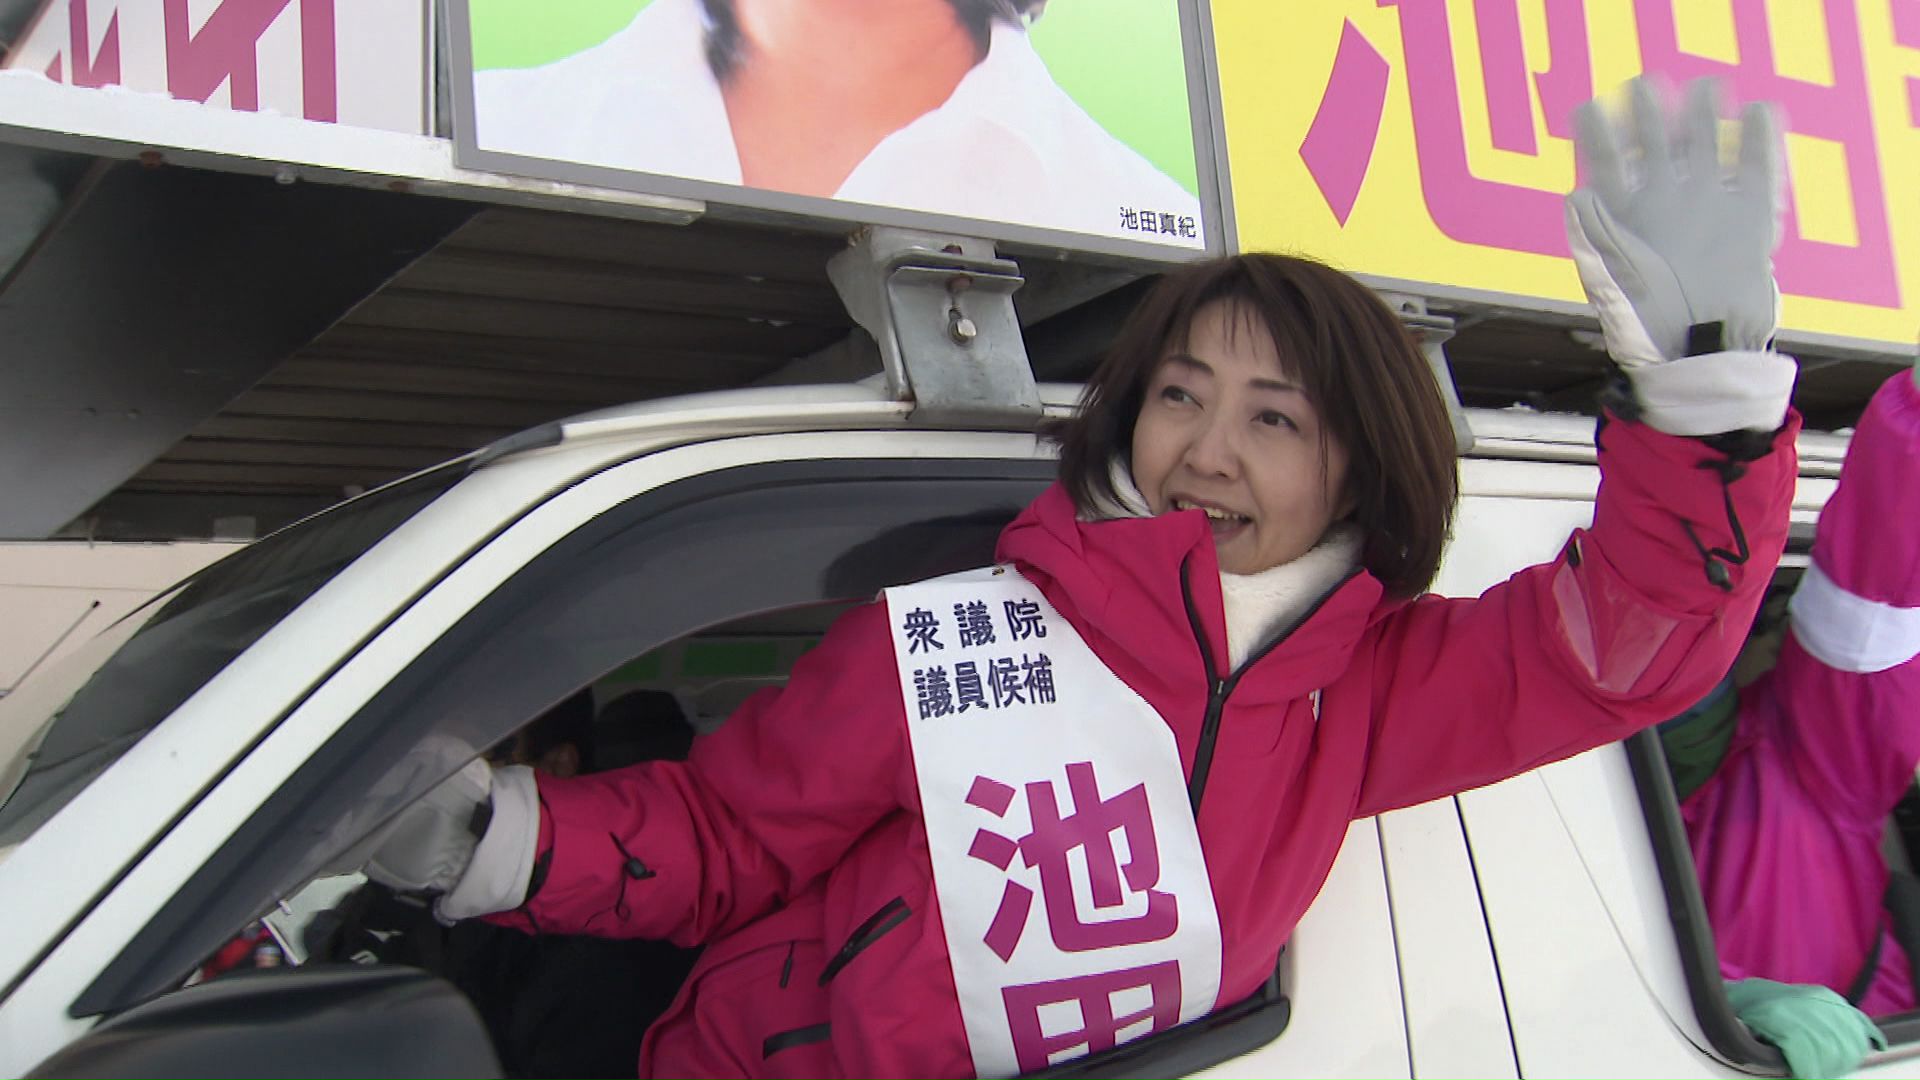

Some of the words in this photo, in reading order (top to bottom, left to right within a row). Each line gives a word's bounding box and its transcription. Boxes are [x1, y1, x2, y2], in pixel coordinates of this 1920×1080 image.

[1299, 0, 1920, 309] 池田
[1119, 206, 1197, 238] 池田真紀
[903, 598, 1047, 655] 衆議院
[913, 652, 1057, 720] 議員候補
[965, 761, 1182, 1076] 池田
